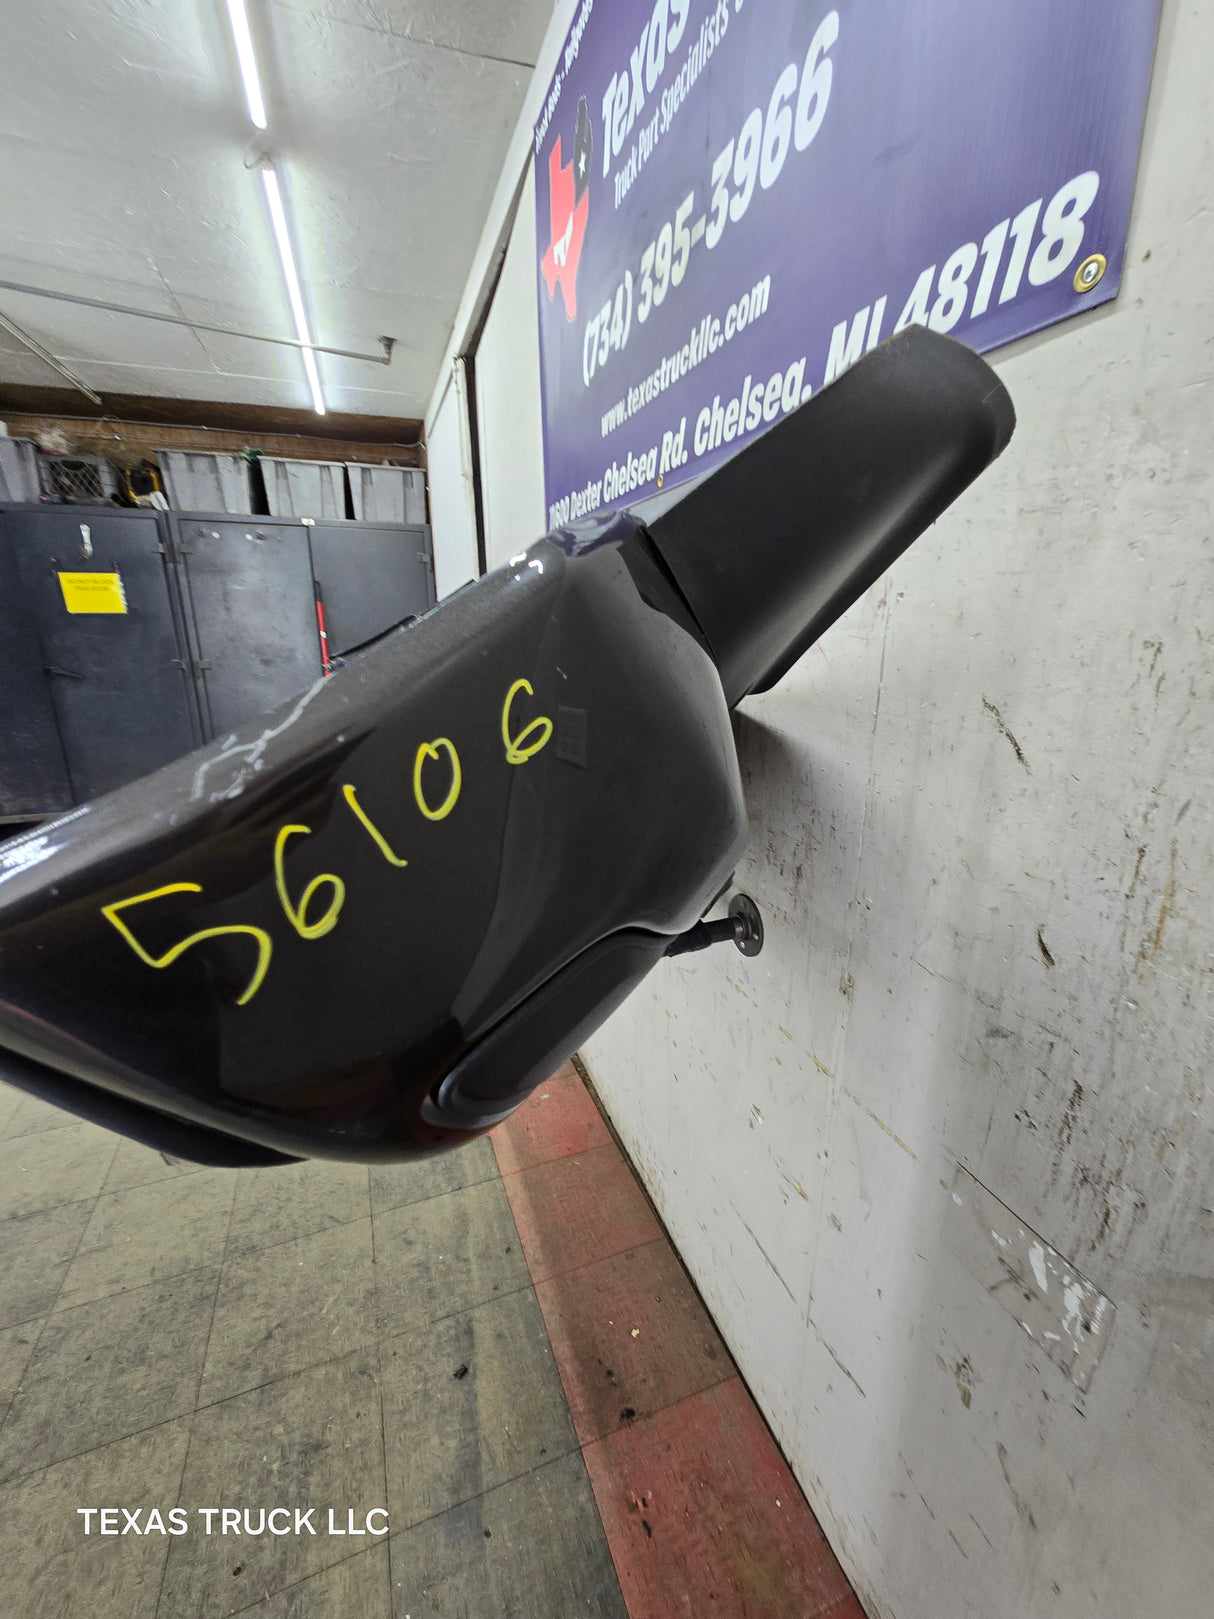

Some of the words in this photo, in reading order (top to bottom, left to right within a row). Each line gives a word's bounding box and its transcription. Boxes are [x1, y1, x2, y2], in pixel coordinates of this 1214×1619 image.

[583, 270, 633, 387] (734)
[637, 10, 840, 324] 395-3966
[614, 145, 638, 210] Truck
[638, 106, 660, 172] Part
[660, 0, 729, 133] Specialists
[570, 480, 603, 520] Dexter
[603, 447, 658, 503] Chelsea
[659, 416, 689, 476] Rd.
[823, 295, 888, 387] MI
[893, 170, 1100, 336] 48118
[601, 274, 771, 438] www.texastruckllc.com
[101, 678, 552, 1005] 56106
